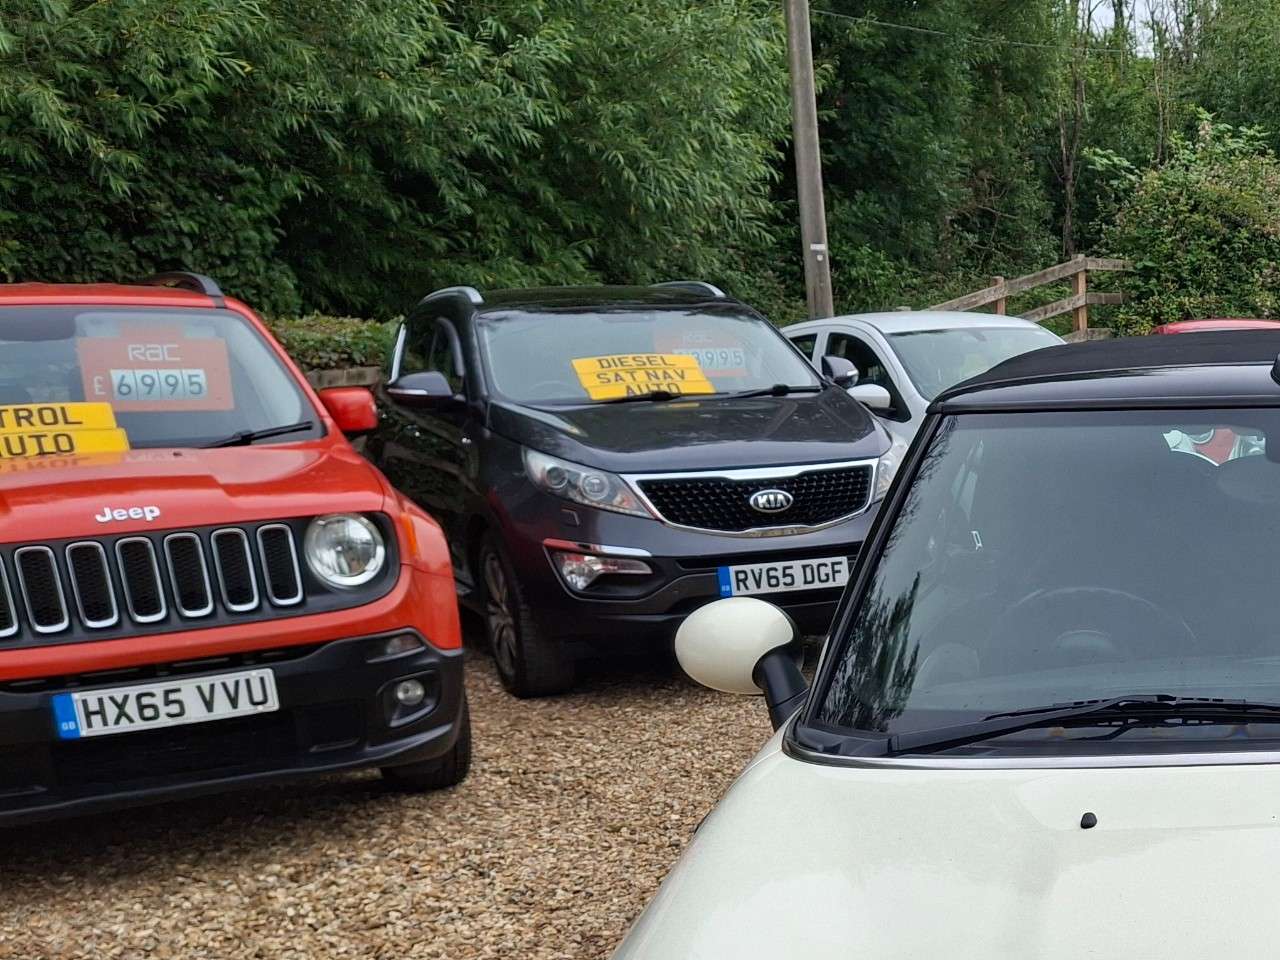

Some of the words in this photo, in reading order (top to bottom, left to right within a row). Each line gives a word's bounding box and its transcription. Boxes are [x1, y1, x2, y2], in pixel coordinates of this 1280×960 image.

[597, 356, 676, 369] DIESEL
[596, 372, 641, 384] SAT
[645, 369, 686, 382] NAV
[0, 433, 76, 457] UTO
[757, 493, 788, 508] KIA
[95, 505, 161, 523] Jeep
[734, 565, 795, 591] RV65
[801, 561, 843, 585] DGF
[82, 688, 186, 729] HX65
[196, 676, 269, 713] VVU
